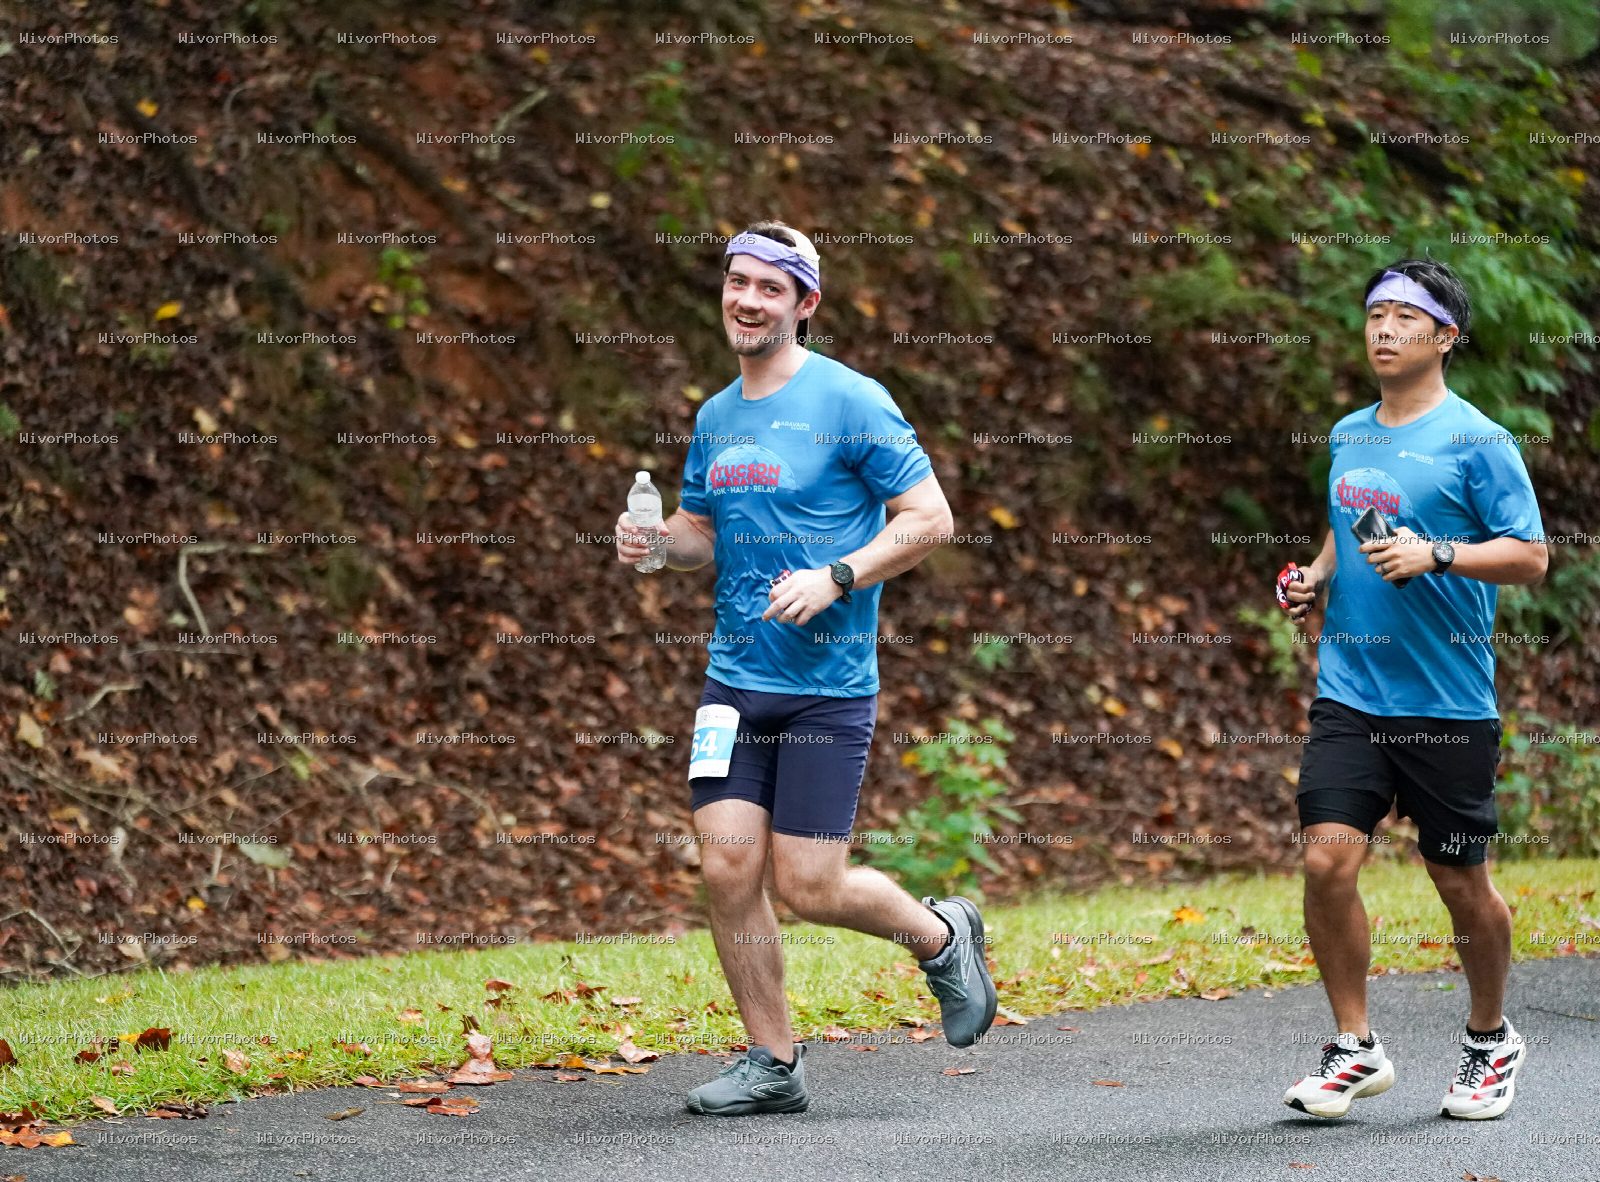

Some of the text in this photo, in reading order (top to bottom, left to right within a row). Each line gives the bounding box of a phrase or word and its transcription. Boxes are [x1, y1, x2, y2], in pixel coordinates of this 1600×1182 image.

[717, 463, 781, 478] TUCSON
[715, 476, 779, 488] MARATHON
[713, 485, 777, 496] 50K HALF RELAY
[1345, 485, 1401, 507] TUCSON
